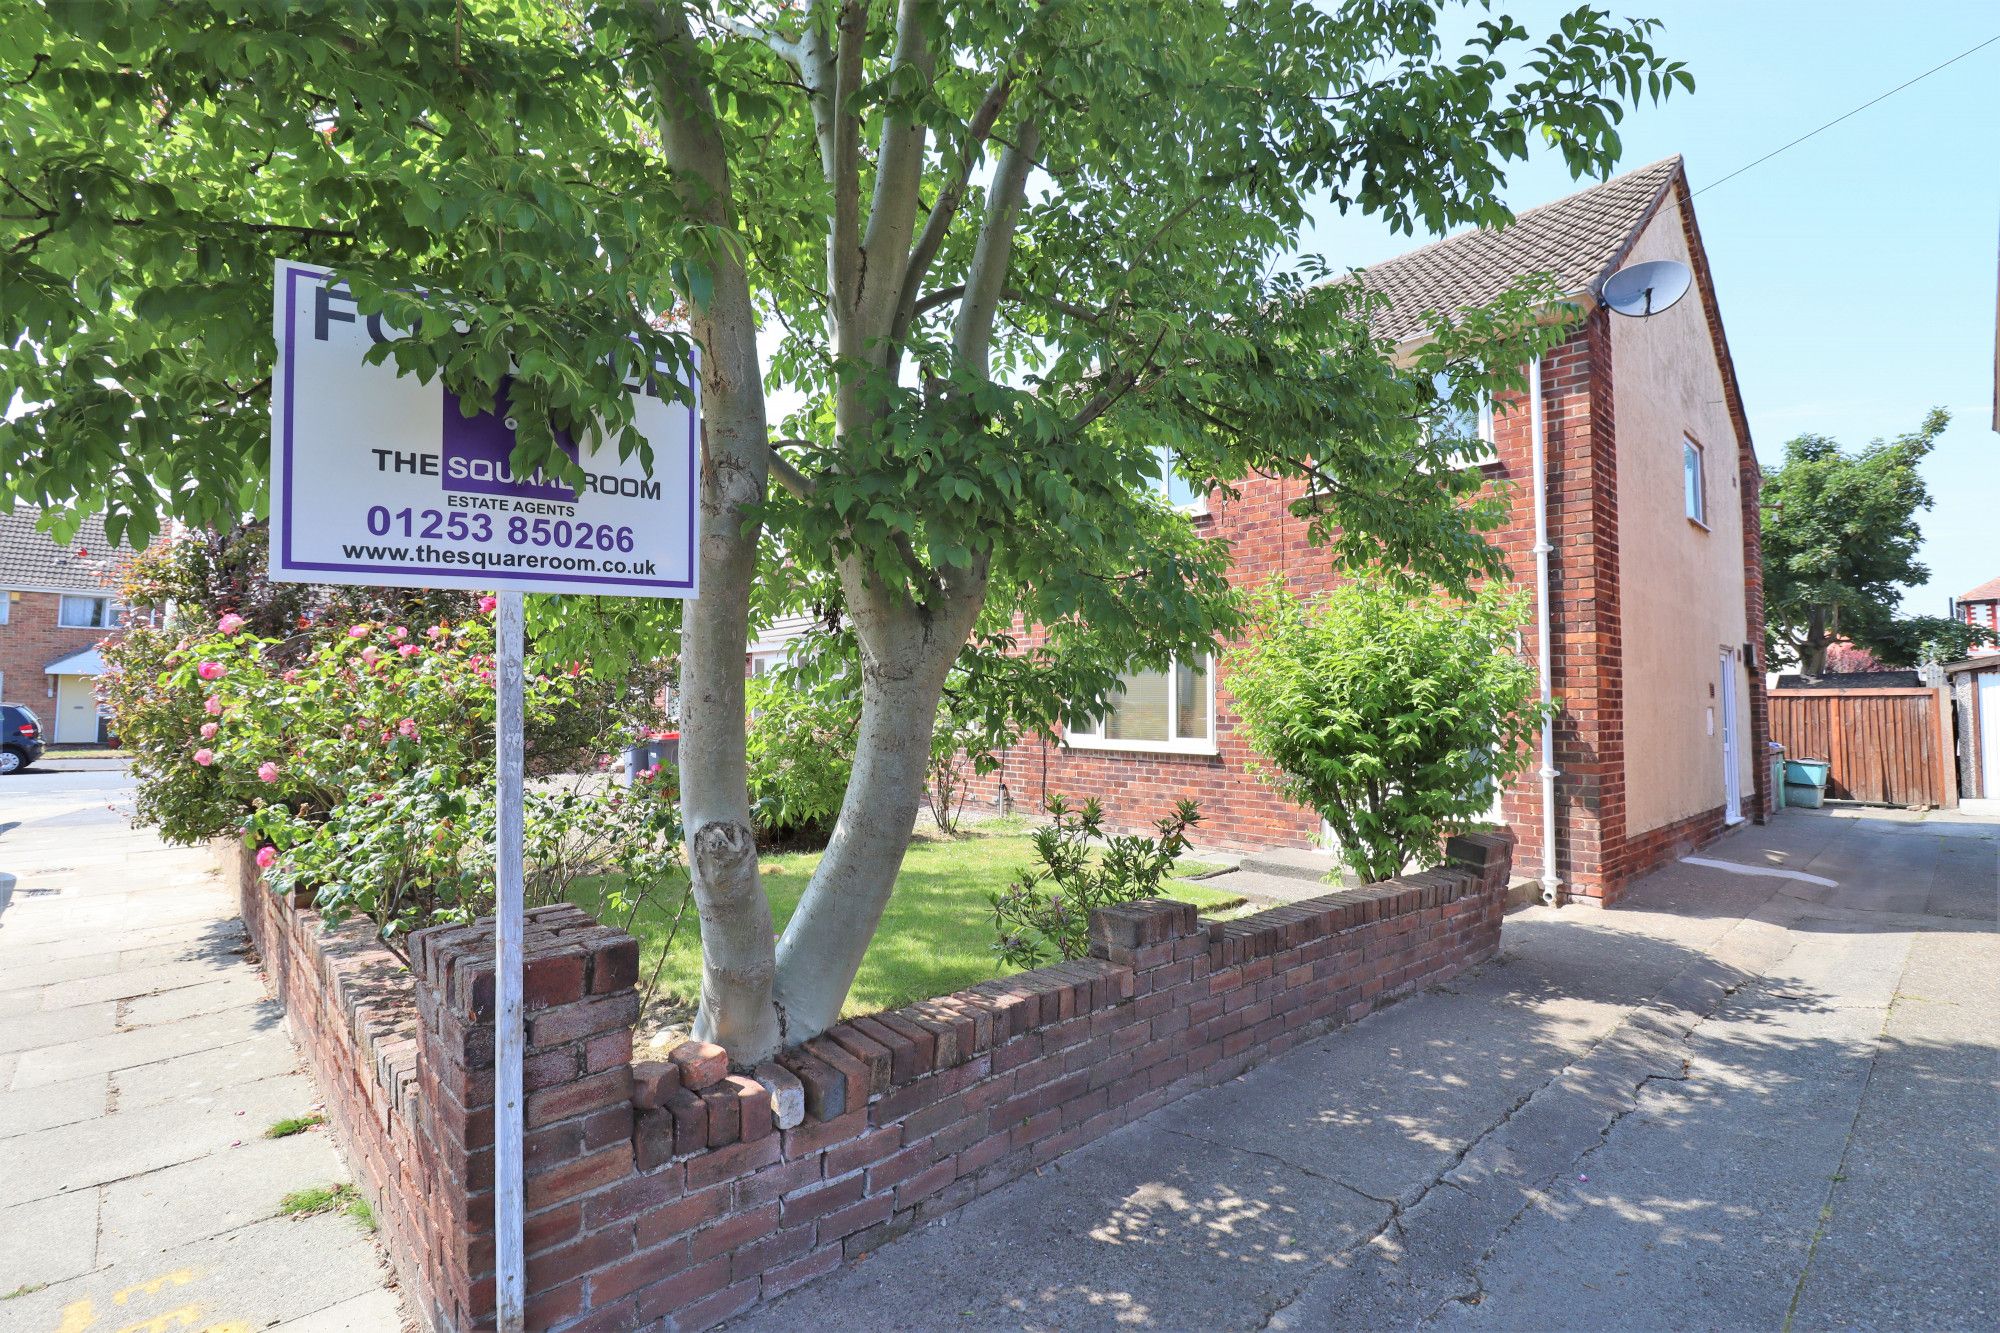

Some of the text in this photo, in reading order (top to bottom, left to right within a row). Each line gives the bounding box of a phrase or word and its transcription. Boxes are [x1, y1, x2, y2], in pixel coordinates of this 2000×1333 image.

[372, 448, 439, 476] THE
[583, 472, 661, 500] ROOM
[447, 495, 575, 517] ESTATE AGENTS
[367, 505, 634, 553] 01253 850266
[342, 544, 656, 576] www.thesquareroom.co.uk
